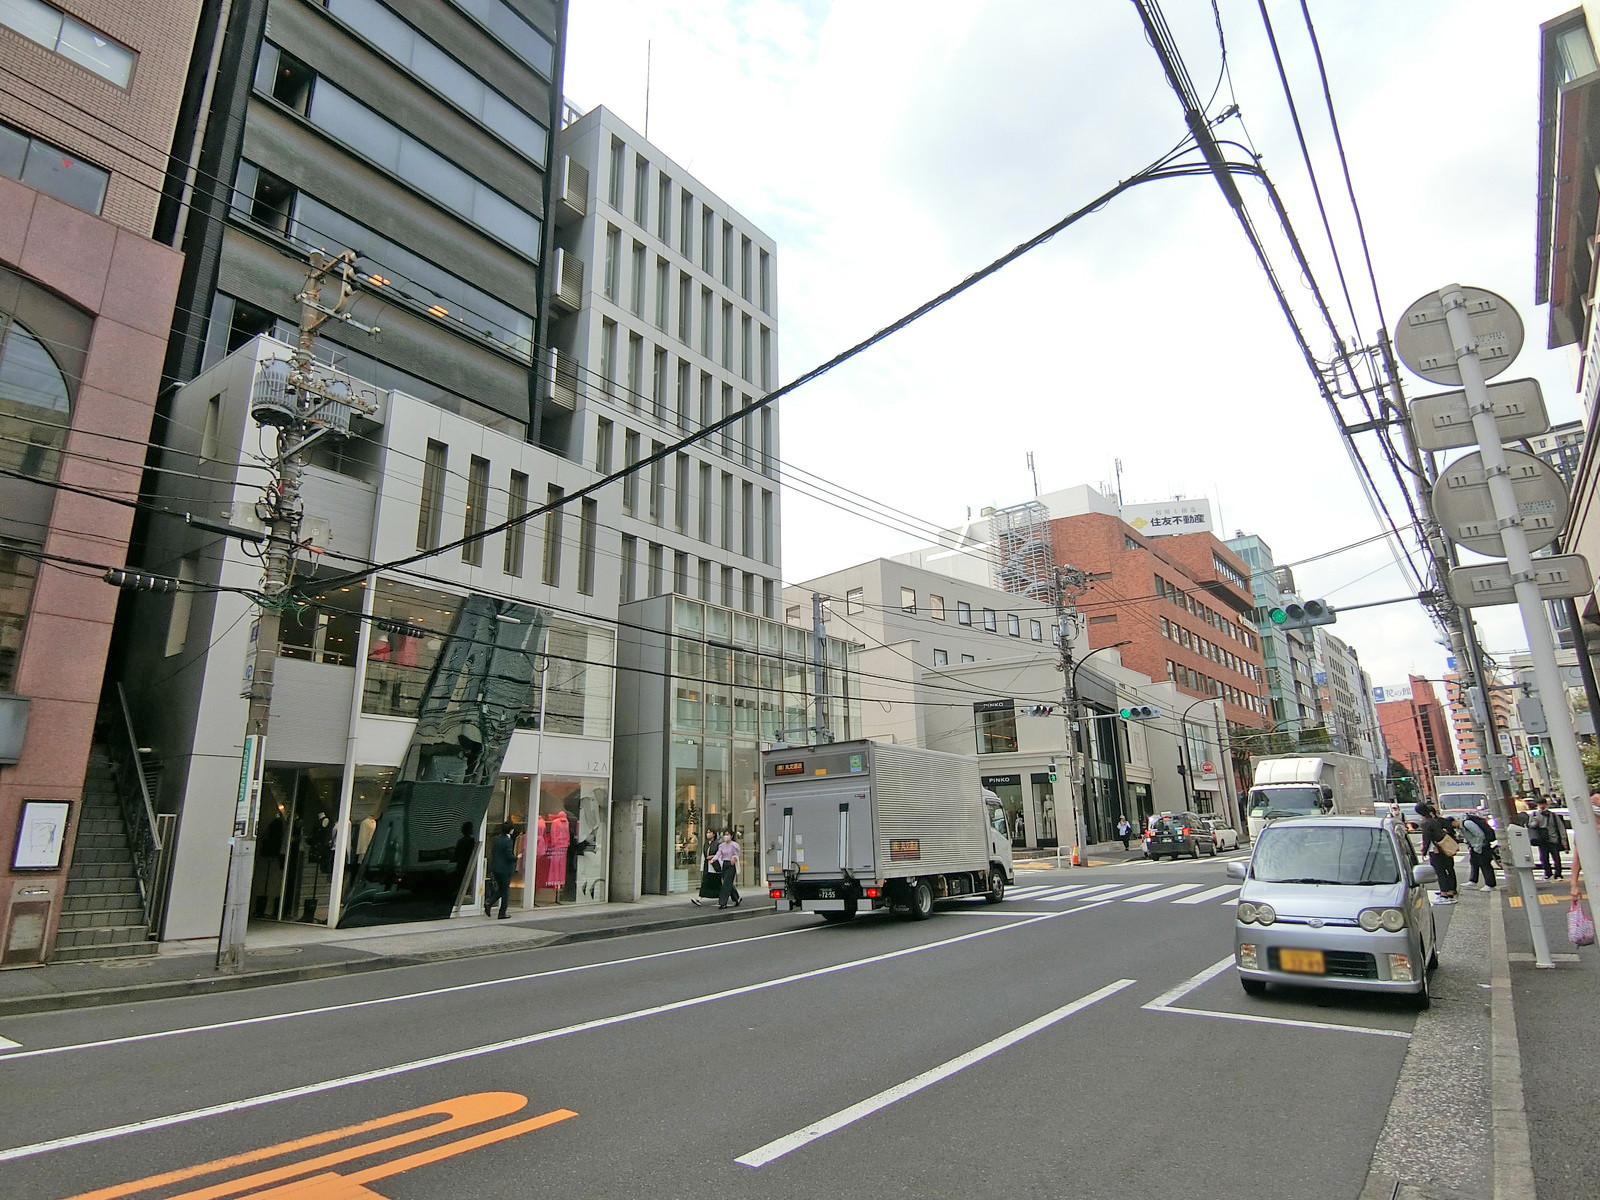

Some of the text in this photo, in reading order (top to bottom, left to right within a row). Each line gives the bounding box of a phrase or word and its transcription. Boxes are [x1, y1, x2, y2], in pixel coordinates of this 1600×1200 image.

[1150, 514, 1205, 526] 住友不動産
[587, 761, 608, 772] IZA
